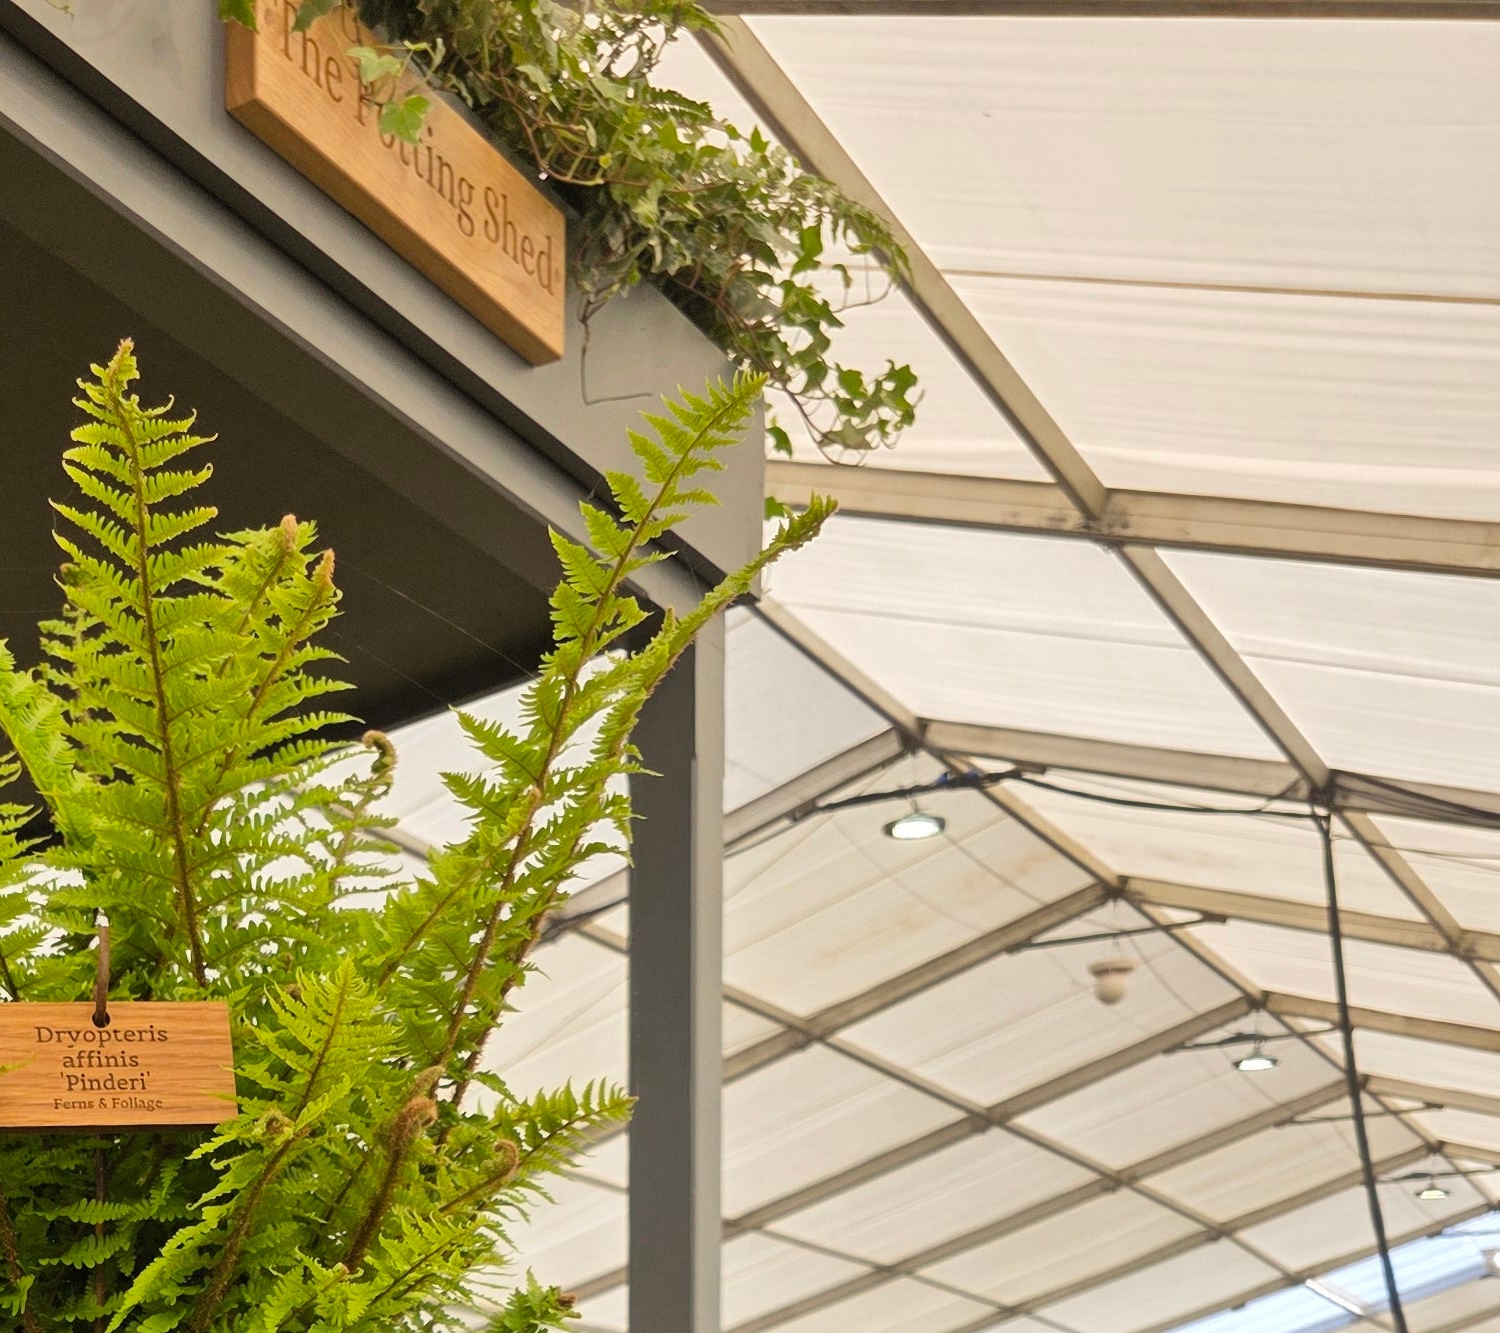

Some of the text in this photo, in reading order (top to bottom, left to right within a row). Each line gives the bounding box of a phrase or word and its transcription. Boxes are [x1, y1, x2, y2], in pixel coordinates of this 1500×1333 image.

[483, 185, 555, 296] Shed
[34, 1025, 169, 1048] Dryopteris
[62, 1050, 140, 1068] affinis
[60, 1071, 151, 1092] 'Pinderi'
[53, 1097, 163, 1112] Ferns & Foliage
